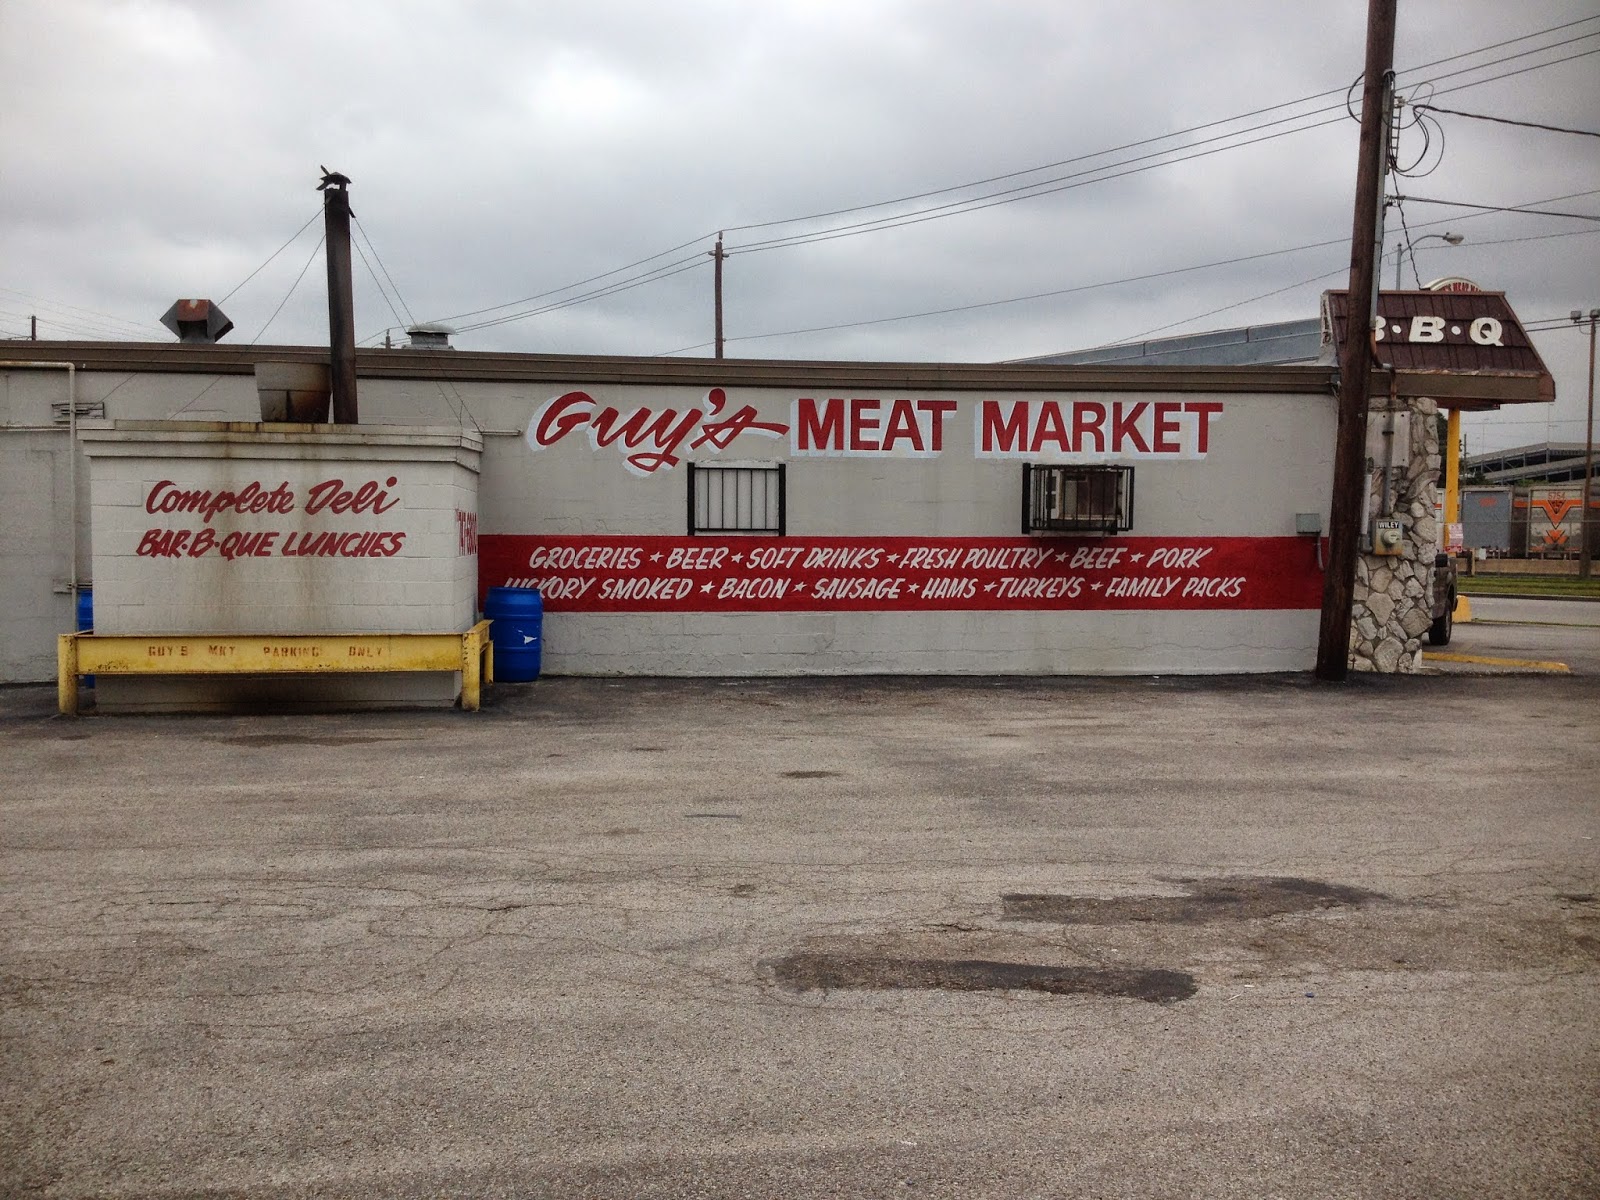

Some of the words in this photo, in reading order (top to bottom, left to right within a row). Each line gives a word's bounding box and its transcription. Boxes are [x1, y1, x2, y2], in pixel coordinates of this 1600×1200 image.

[537, 388, 790, 472] Guy's
[797, 398, 957, 451] MEAT
[981, 400, 1224, 453] MARKET
[146, 480, 294, 523] Complete
[304, 476, 400, 515] Deli
[281, 531, 406, 558] LUNCHES
[529, 546, 644, 570] GROCERIES
[665, 547, 730, 570] BEER
[746, 547, 805, 570] SOFT
[802, 547, 886, 570] DRINKS
[898, 547, 964, 570] FRESH
[959, 547, 1054, 570] POULTRY
[1069, 547, 1128, 570] BEEF
[1146, 546, 1213, 569] PORK
[597, 577, 694, 600] SMOKED
[717, 577, 792, 600] BACON
[810, 577, 906, 600] SAUSAGE
[920, 577, 979, 600] HAMS
[995, 576, 1086, 599] TURKEYS
[1104, 576, 1181, 598] FAMILY
[1181, 576, 1247, 598] PACKS
[263, 646, 320, 657] PARKING
